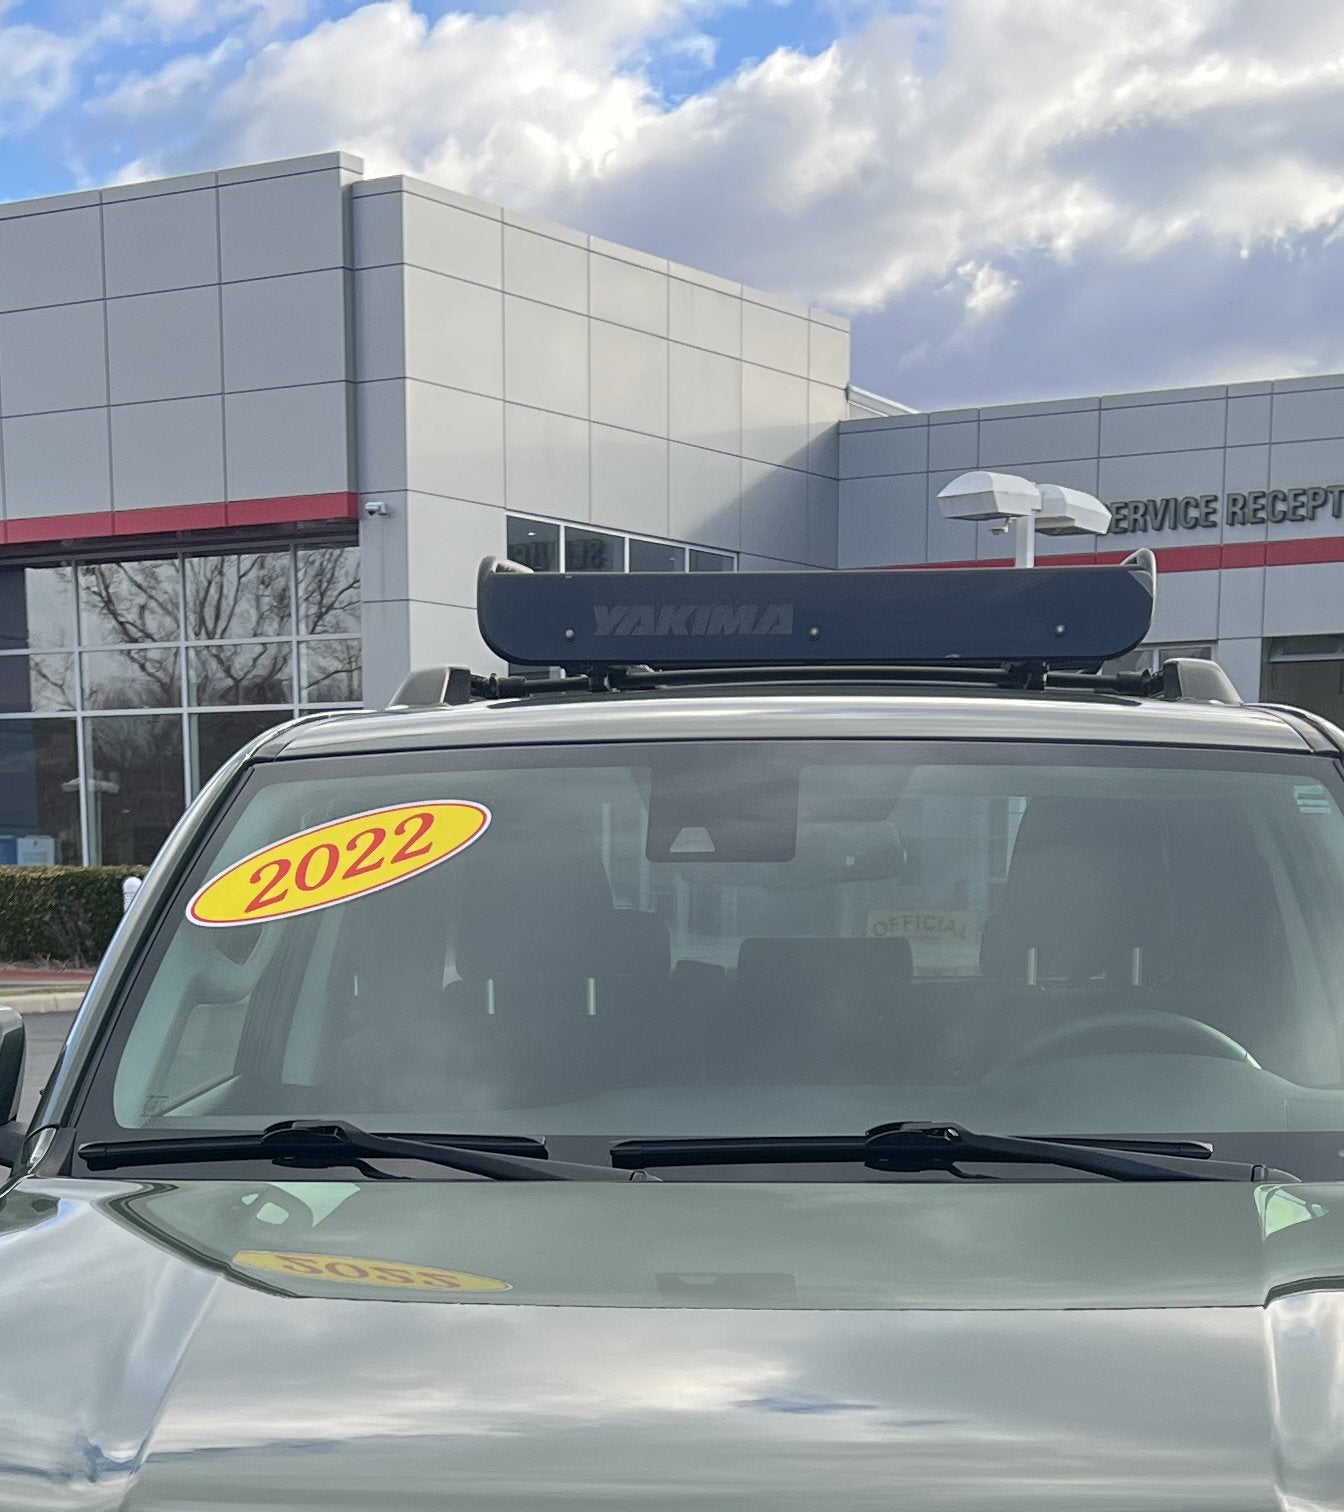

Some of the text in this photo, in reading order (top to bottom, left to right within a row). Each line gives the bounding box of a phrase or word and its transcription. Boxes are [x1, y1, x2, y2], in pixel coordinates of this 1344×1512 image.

[1107, 494, 1218, 535] ERVICE
[593, 603, 794, 637] YAKIMA
[243, 812, 435, 914] 2022
